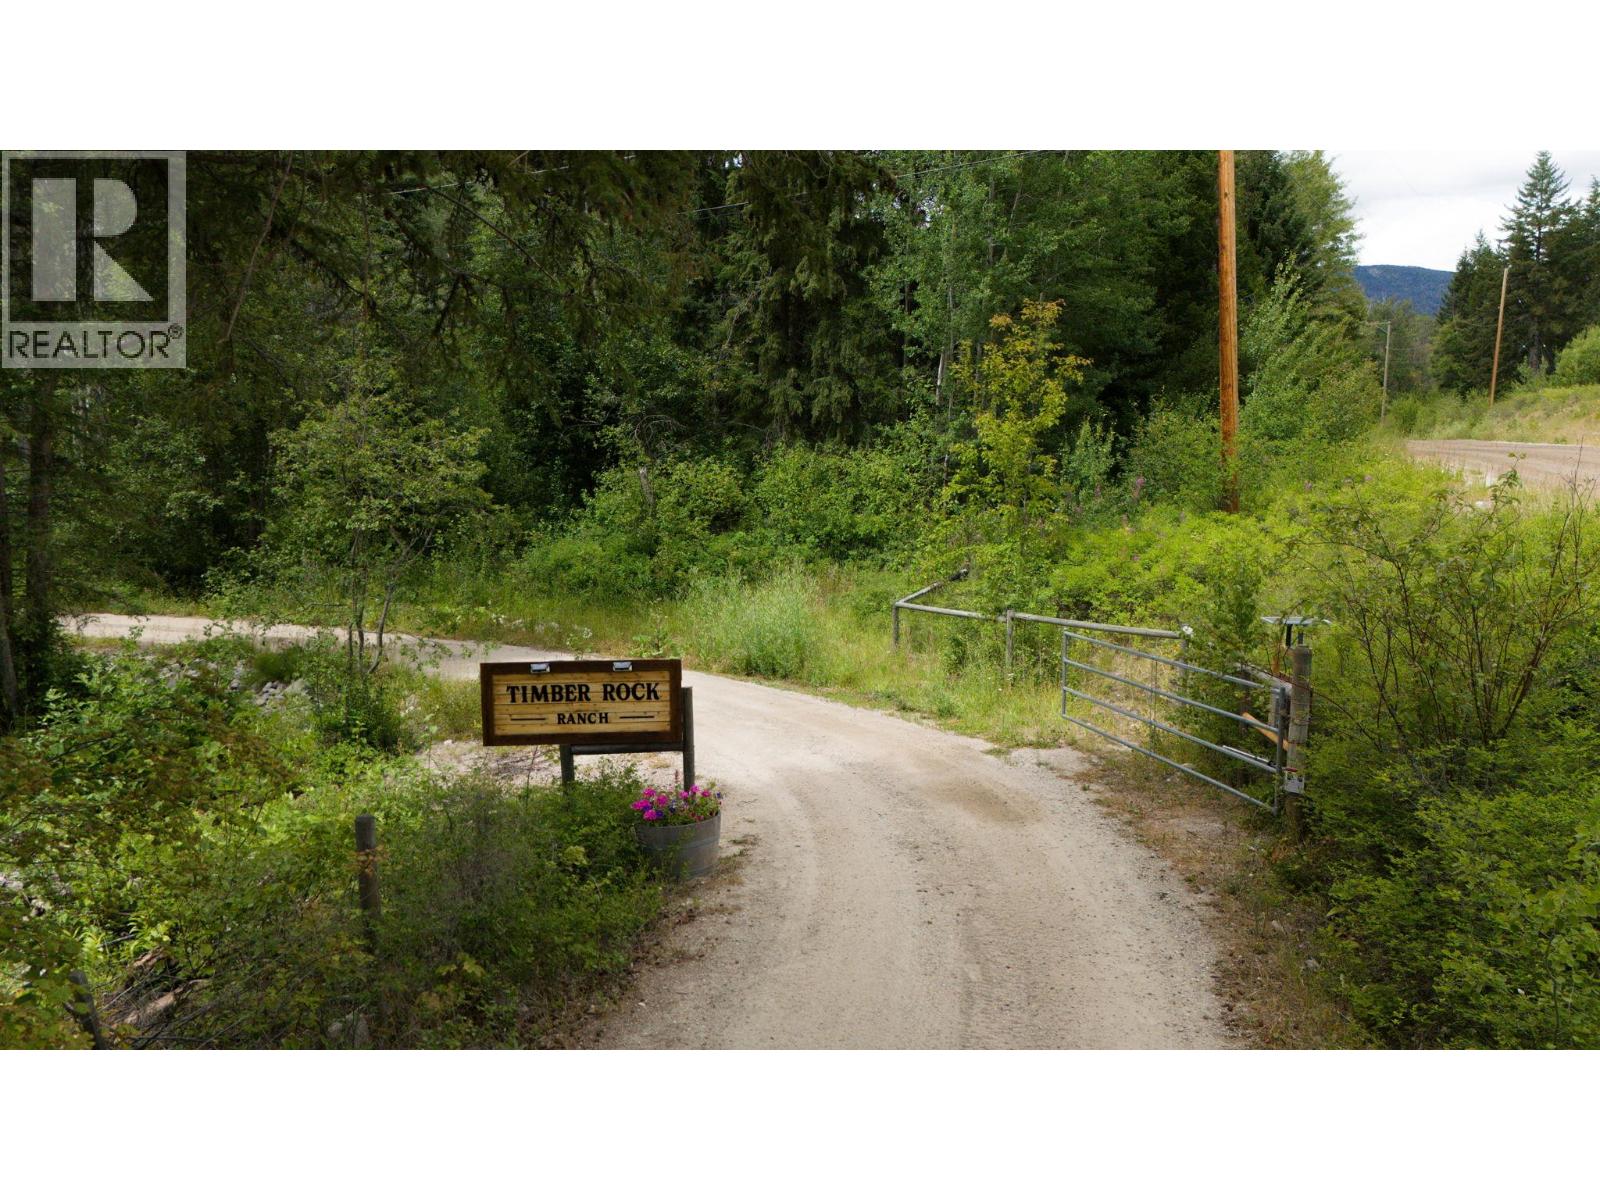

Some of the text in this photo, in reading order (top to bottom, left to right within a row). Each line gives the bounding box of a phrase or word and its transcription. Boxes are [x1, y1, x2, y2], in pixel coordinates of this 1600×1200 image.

[506, 682, 660, 704] TIMBER ROCK
[557, 712, 609, 725] RANCH
